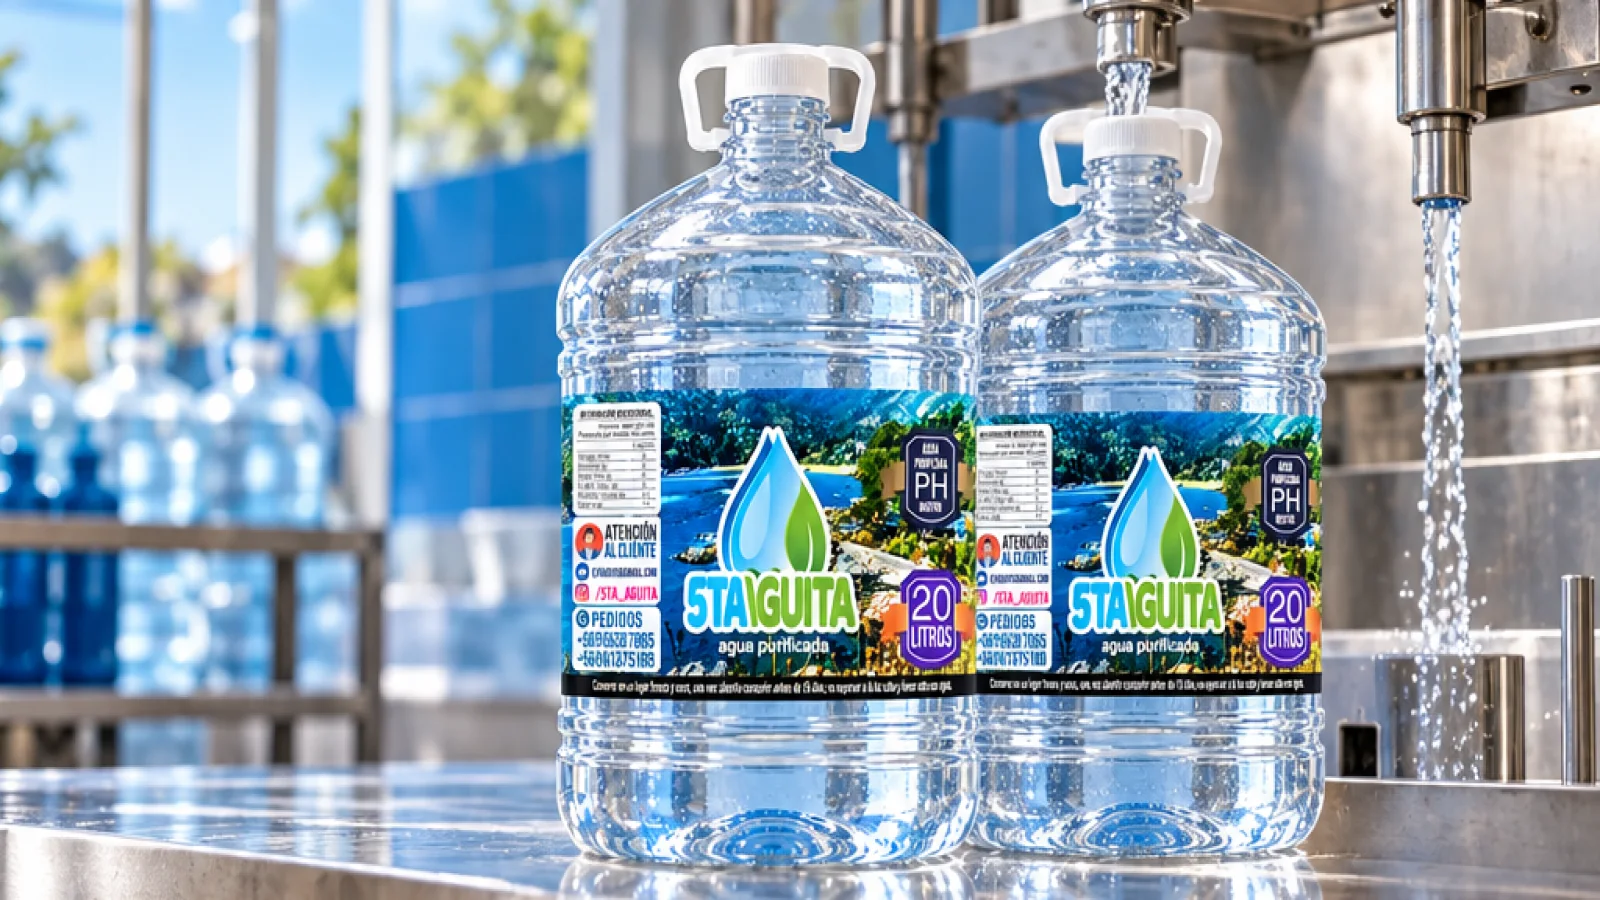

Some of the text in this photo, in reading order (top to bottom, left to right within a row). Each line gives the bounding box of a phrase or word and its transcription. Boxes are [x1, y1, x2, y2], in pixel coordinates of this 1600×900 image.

[915, 472, 948, 499] PH
[1271, 487, 1300, 513] PH
[911, 584, 951, 621] 20
[1269, 590, 1303, 623] 20
[718, 636, 829, 657] agua purificada
[910, 625, 953, 648] LITROS
[1101, 639, 1134, 655] agua
[1268, 627, 1304, 649] LITROS
